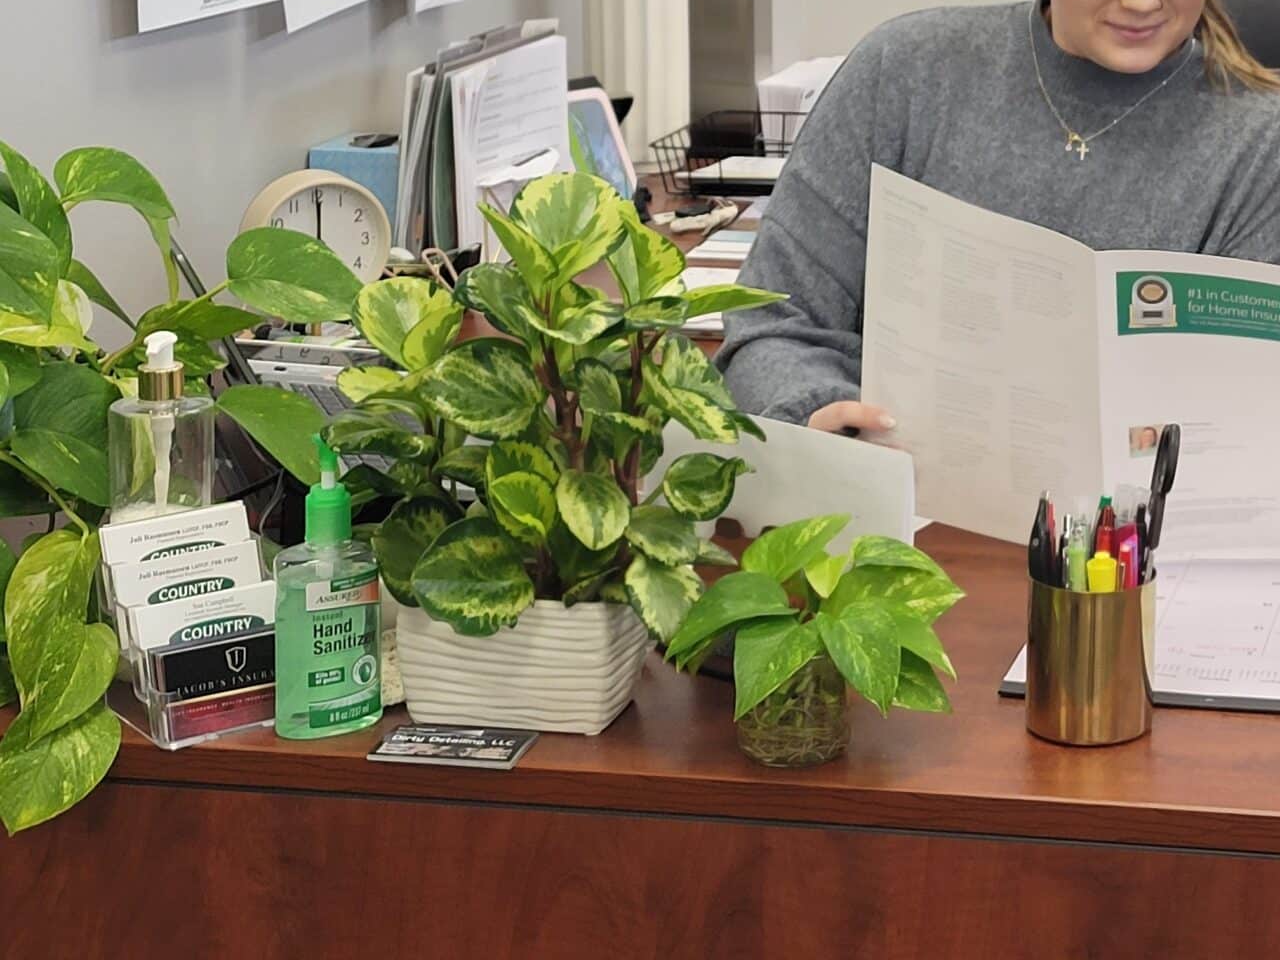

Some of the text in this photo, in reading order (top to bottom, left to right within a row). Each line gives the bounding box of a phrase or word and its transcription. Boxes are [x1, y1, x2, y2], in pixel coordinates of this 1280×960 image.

[289, 199, 299, 214] 11
[353, 208, 362, 223] 2
[361, 231, 370, 246] 3
[353, 256, 361, 269] 4
[1188, 288, 1203, 300] #1
[1206, 290, 1217, 301] in
[1188, 300, 1206, 313] for
[1208, 303, 1248, 318] Home
[158, 578, 224, 601] COUNTRY
[181, 617, 252, 641] COUNTRY
[313, 617, 353, 639] Hand
[176, 679, 226, 697] JACOB'S
[391, 734, 425, 743] Dirty
[491, 738, 516, 747] LLC
